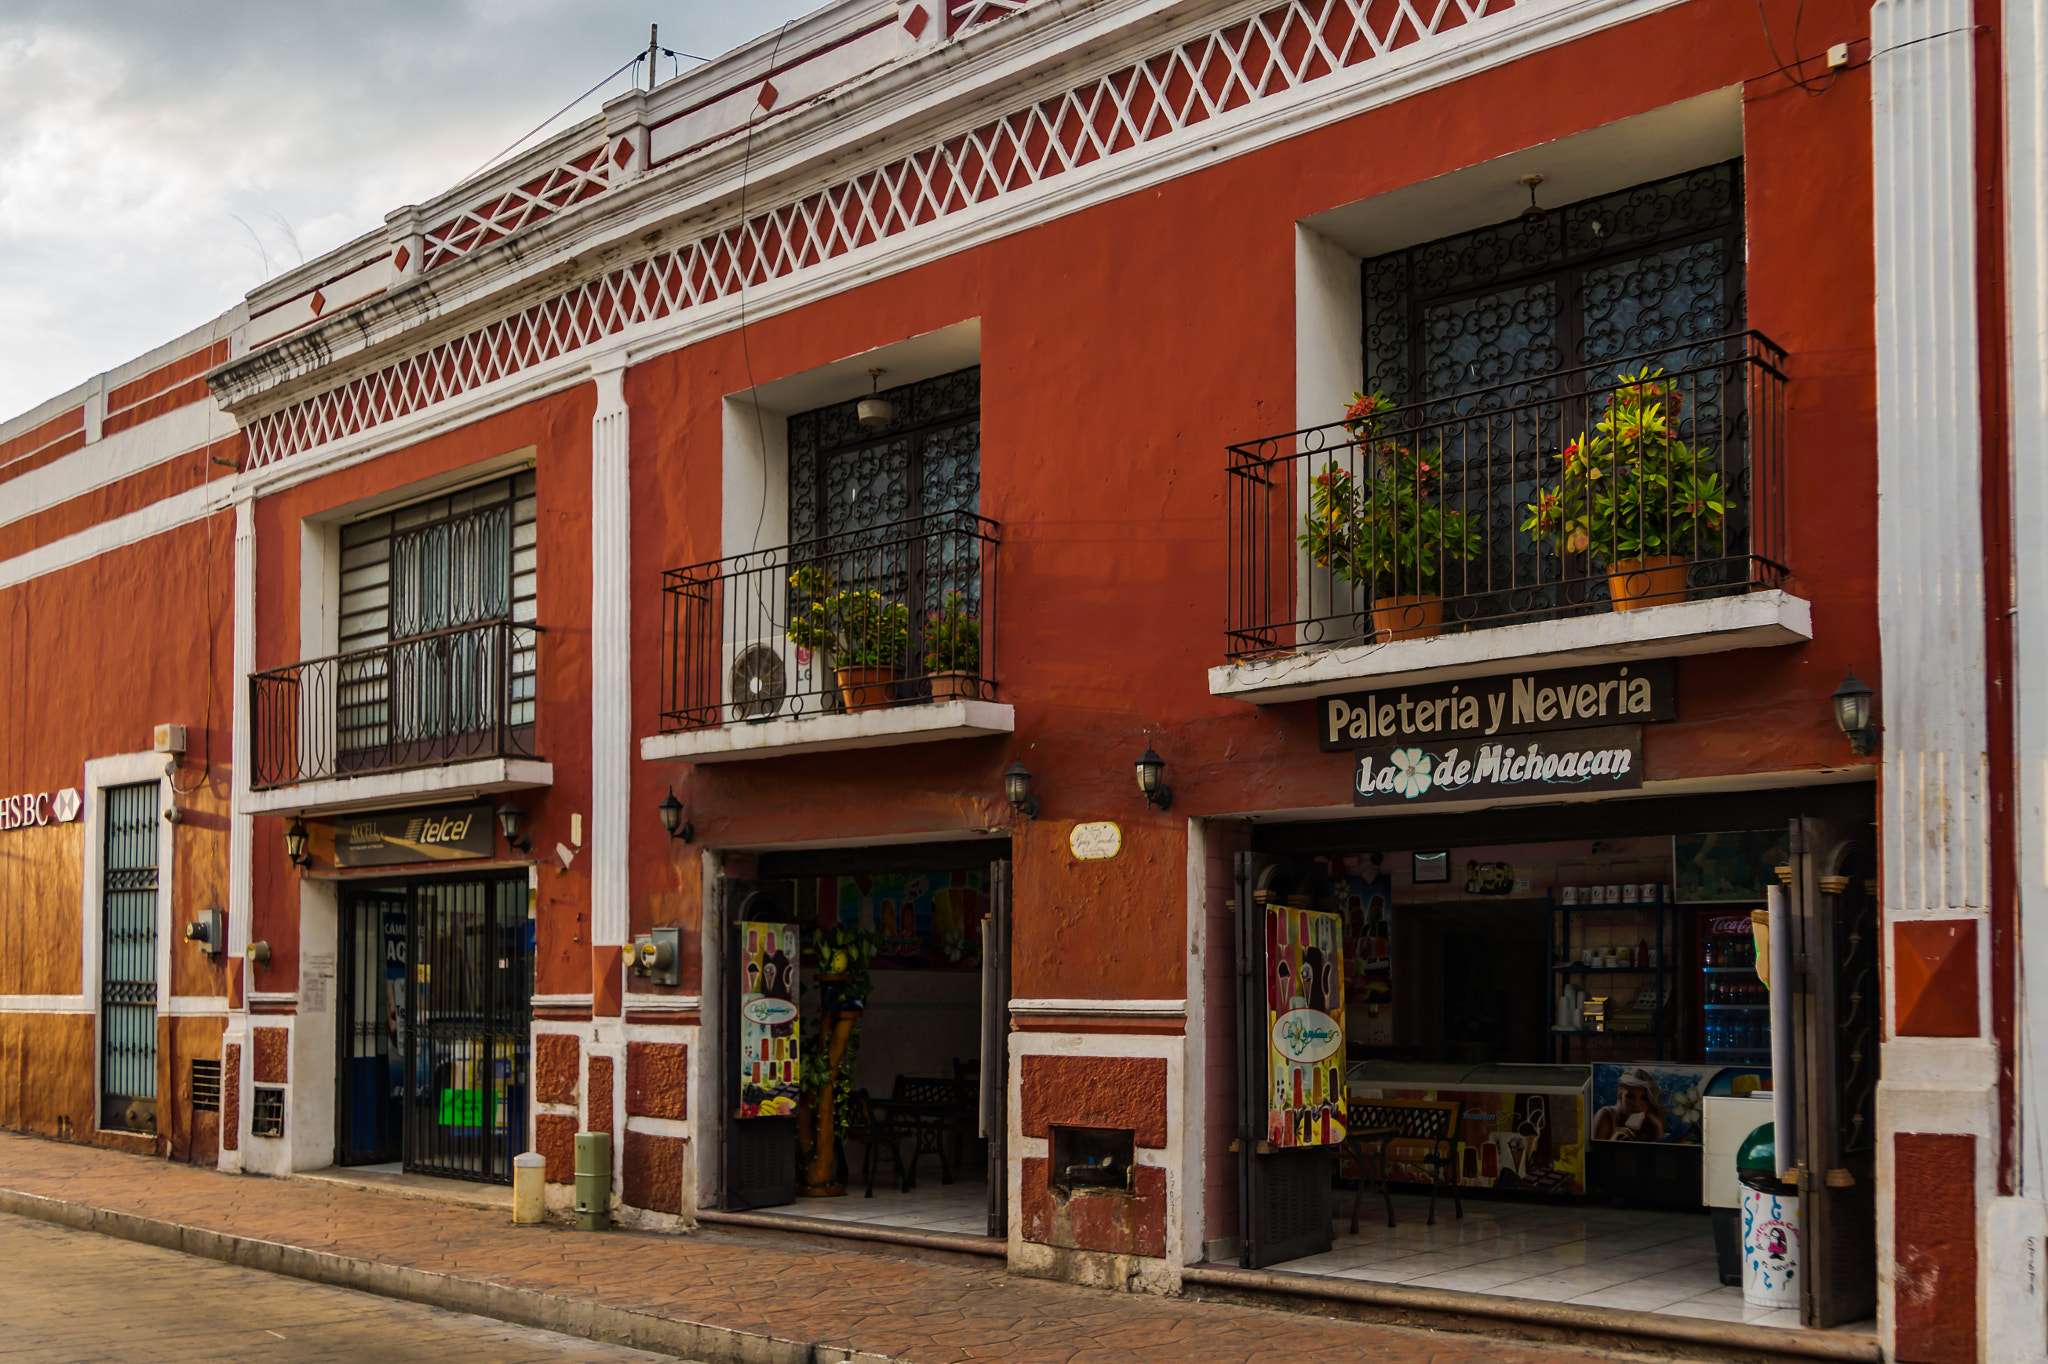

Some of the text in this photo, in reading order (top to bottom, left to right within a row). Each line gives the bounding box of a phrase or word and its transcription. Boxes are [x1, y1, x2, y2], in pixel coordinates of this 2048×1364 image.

[1327, 666, 1652, 742] Paleteria y Neveria
[1357, 744, 1632, 793] La de Michoacan
[0, 792, 49, 830] HSBC
[420, 813, 473, 844] telcel
